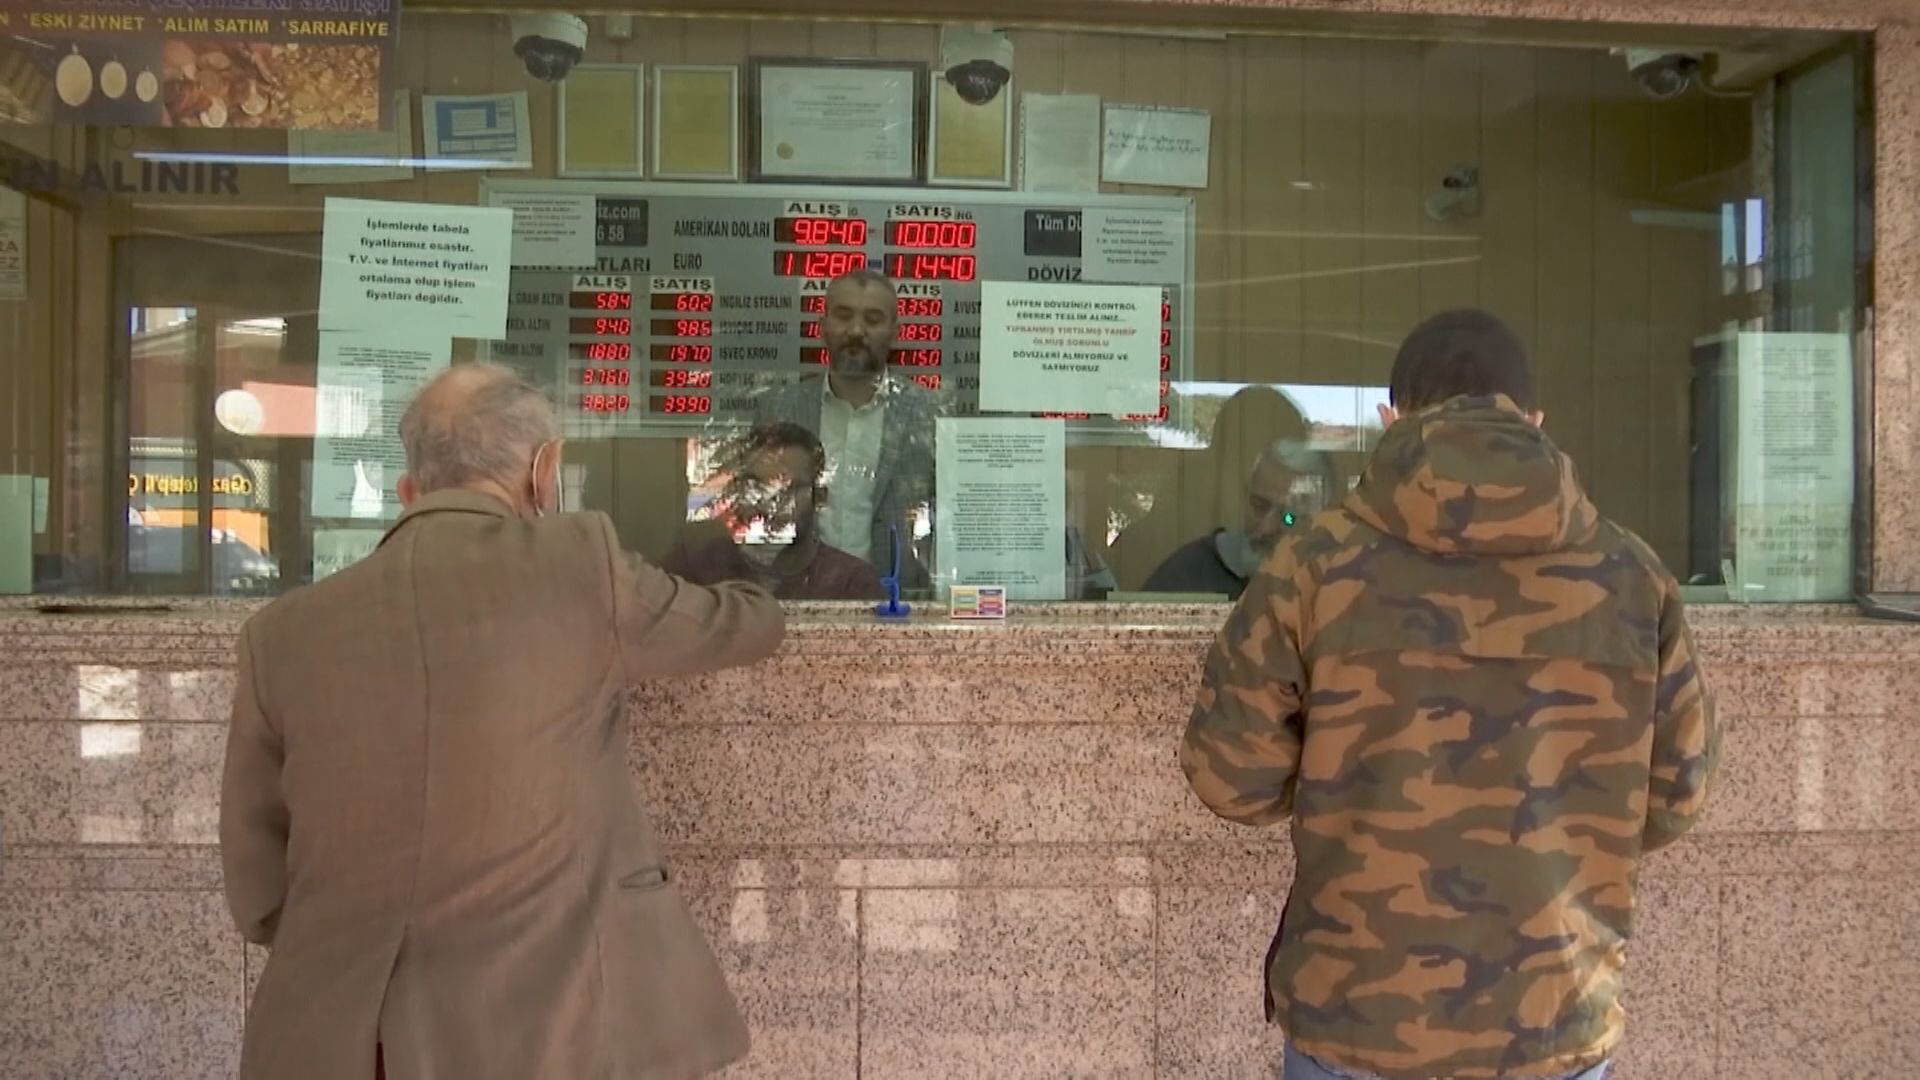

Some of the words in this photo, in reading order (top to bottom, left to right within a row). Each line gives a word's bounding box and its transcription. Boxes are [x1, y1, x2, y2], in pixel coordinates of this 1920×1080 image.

[214, 18, 269, 34] SATIM
[432, 223, 470, 235] tabela
[732, 221, 770, 238] DOLARI
[1035, 214, 1064, 231] Tüm
[607, 224, 625, 242] 58
[375, 256, 389, 266] ve
[673, 253, 703, 270] EURO
[359, 273, 411, 286] ortalama
[414, 275, 440, 288] olup
[596, 293, 632, 309] 584
[676, 294, 713, 310] 602
[1094, 302, 1136, 311] KONTROL
[595, 318, 631, 334] 940
[664, 396, 711, 413] 3990
